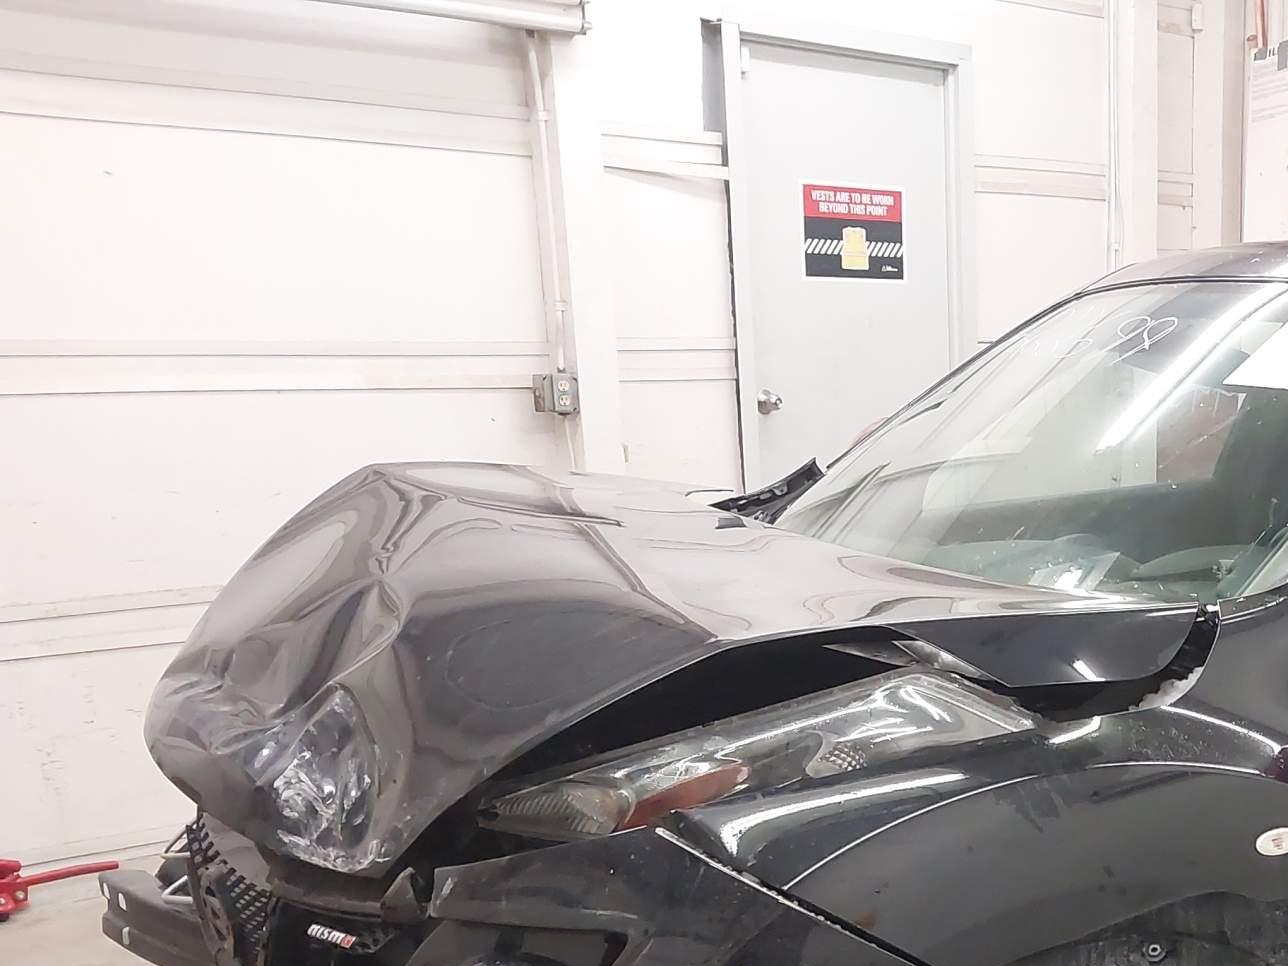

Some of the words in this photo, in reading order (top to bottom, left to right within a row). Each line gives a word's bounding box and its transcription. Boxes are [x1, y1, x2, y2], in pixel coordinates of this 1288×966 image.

[811, 189, 835, 201] VESTS
[835, 191, 851, 203] ARE
[851, 192, 861, 203] TO
[871, 194, 894, 206] WORN
[818, 202, 848, 213] BEYOND
[849, 203, 866, 215] THIS
[866, 205, 887, 216] POINT
